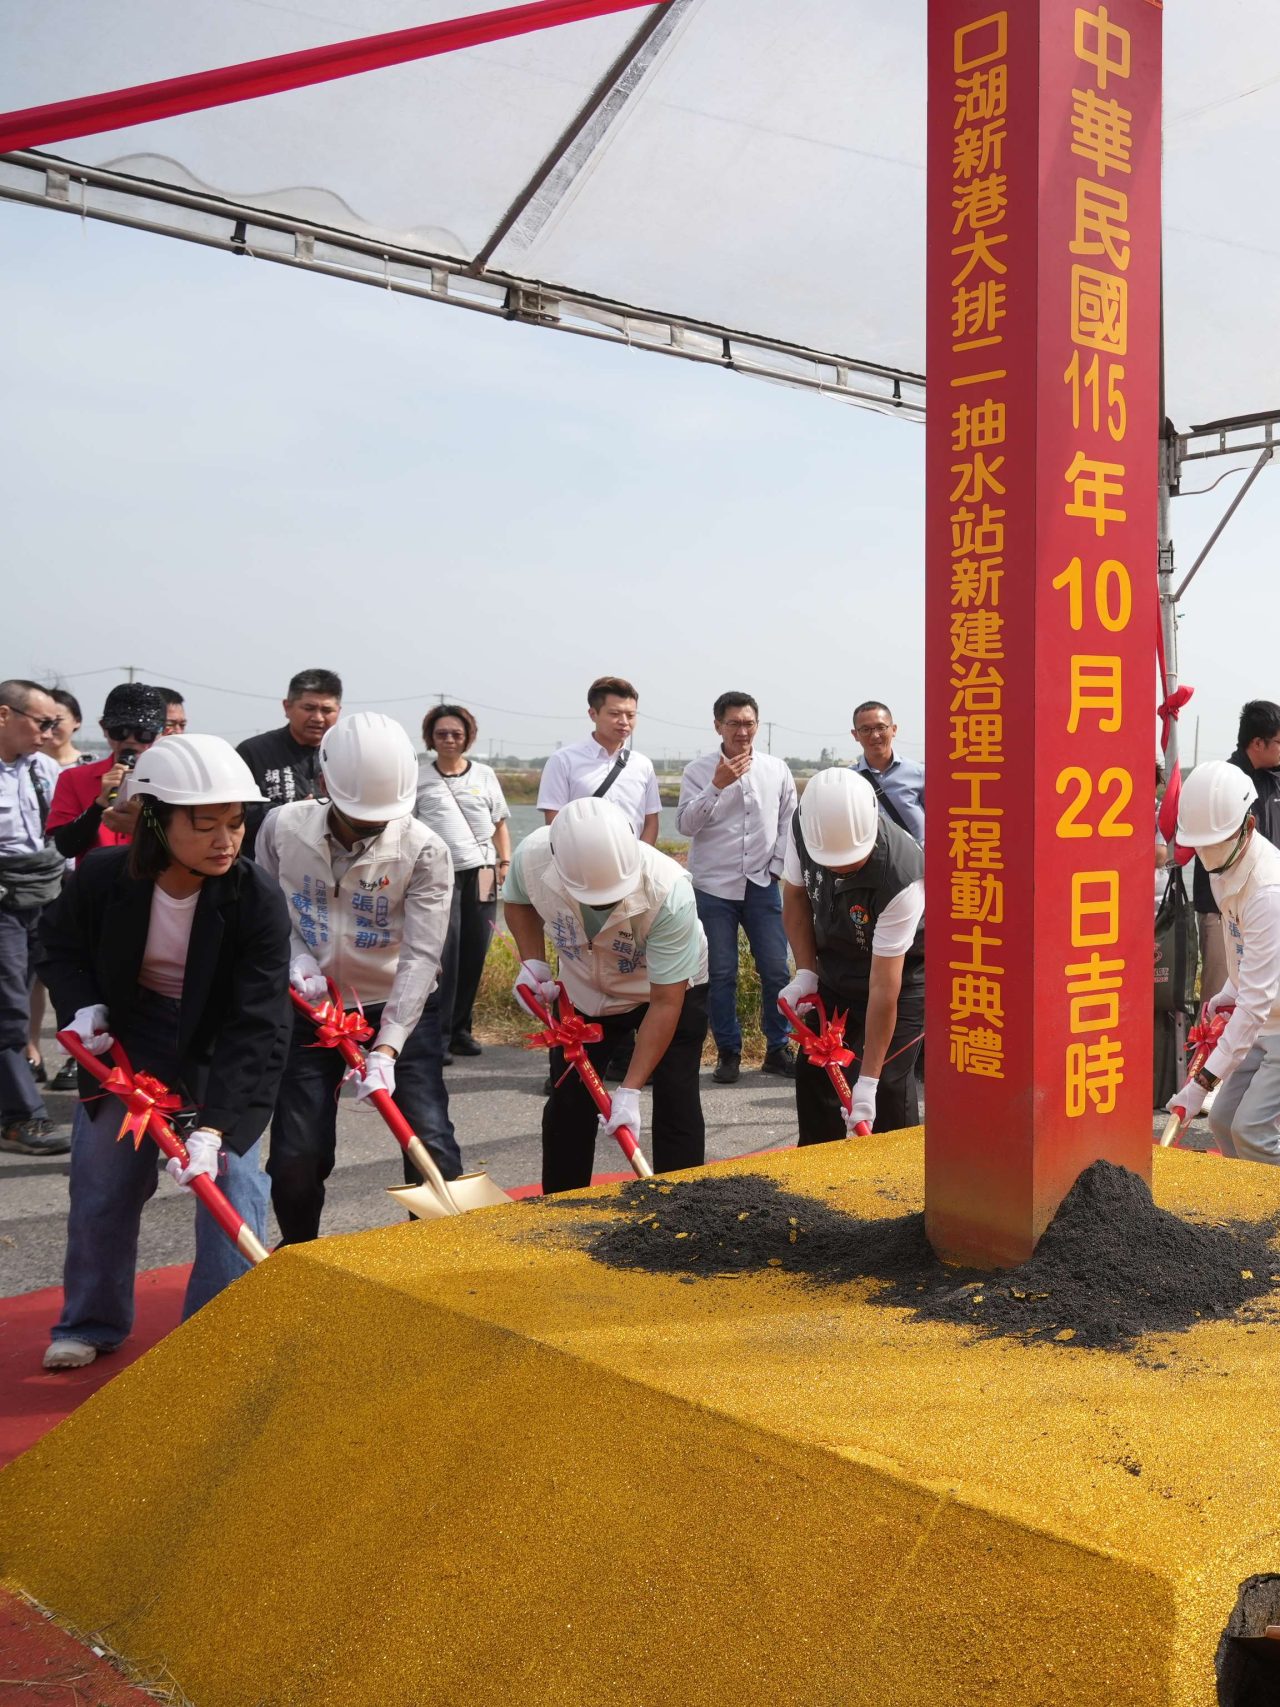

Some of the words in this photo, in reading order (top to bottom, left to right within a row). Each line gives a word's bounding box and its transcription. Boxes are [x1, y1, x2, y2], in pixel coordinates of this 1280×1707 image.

[949, 12, 1008, 1078] 口湖新港大排二抽水站新建治理工程動土典禮
[1053, 6, 1134, 1118] 中華民國115年10月22日吉時
